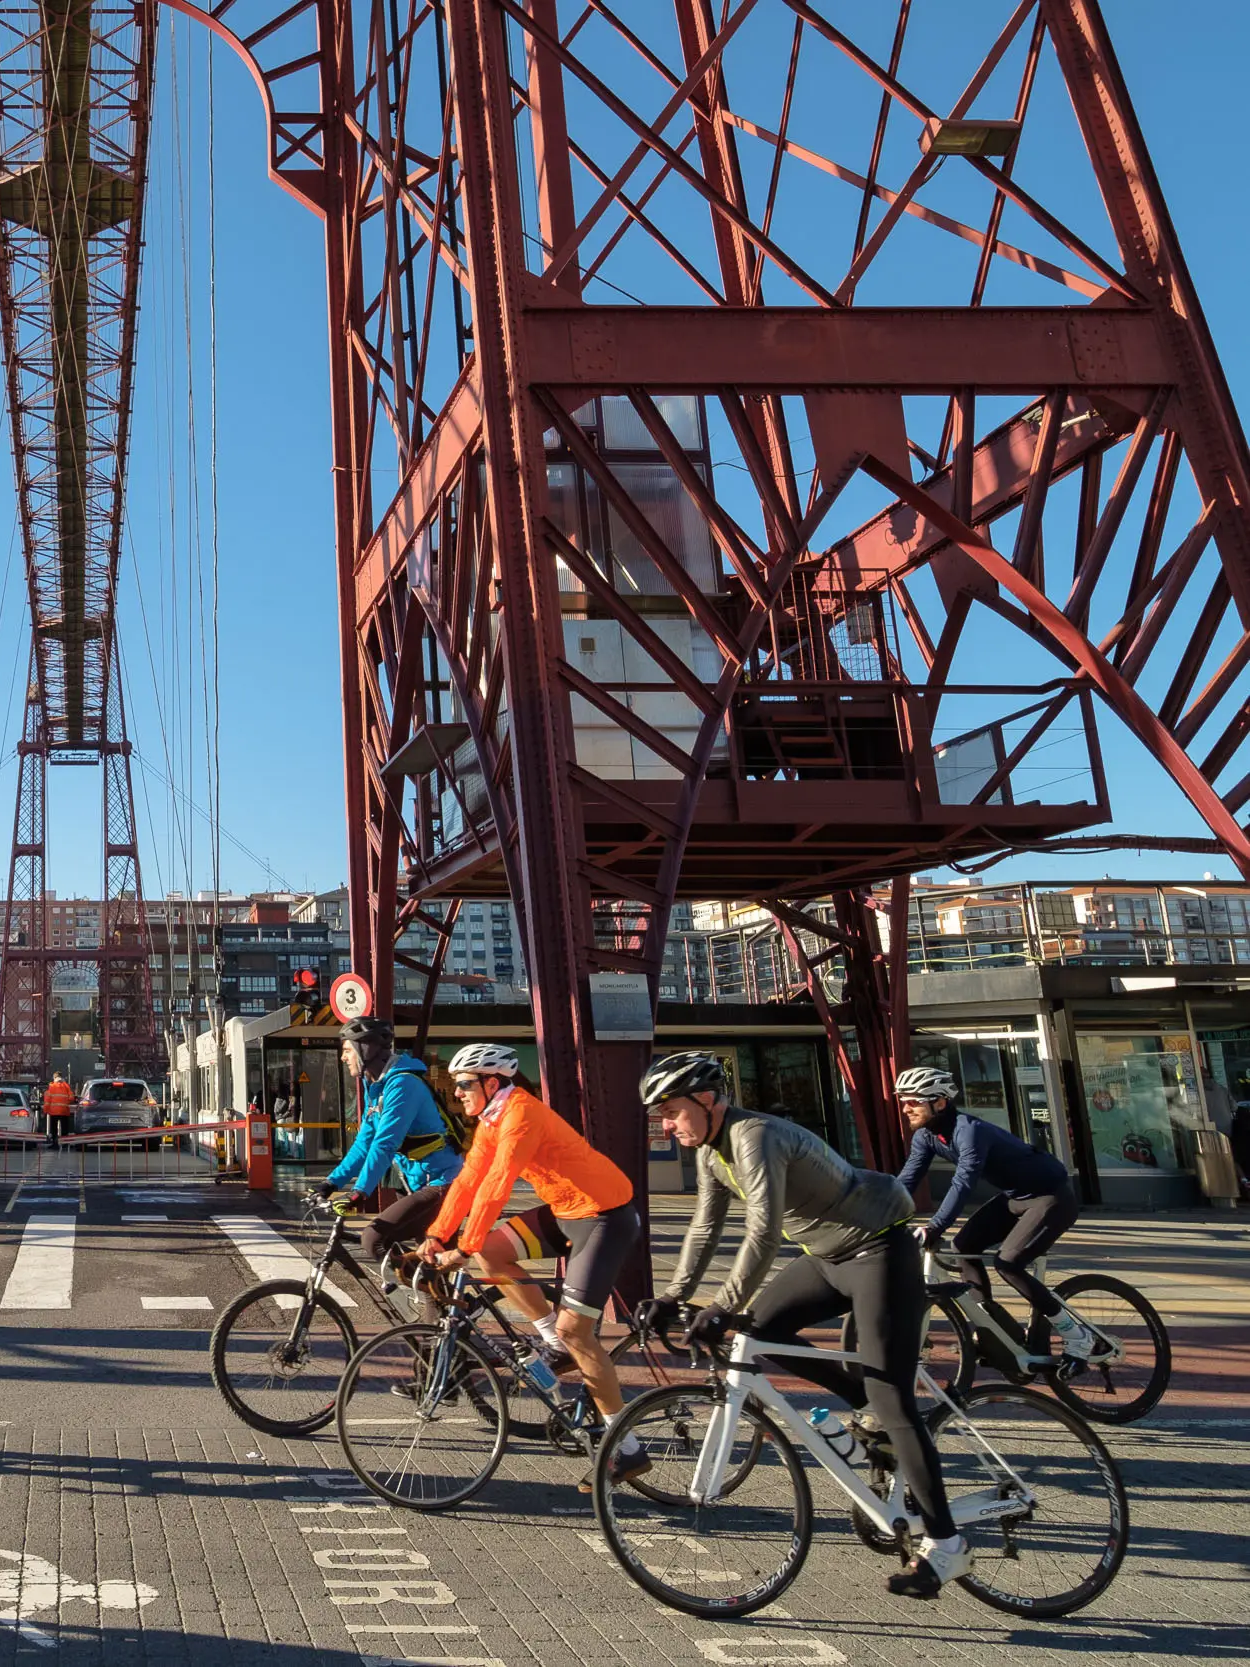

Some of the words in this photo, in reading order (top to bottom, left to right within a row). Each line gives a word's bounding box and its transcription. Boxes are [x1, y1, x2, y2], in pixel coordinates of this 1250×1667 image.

[345, 988, 357, 1005] 3
[481, 1333, 526, 1378] PEUGEOT
[979, 1501, 1024, 1516] ORBEA
[275, 1474, 507, 1667] PRIORI
[746, 1535, 801, 1602] DURA-ACE
[708, 1597, 738, 1607] C35
